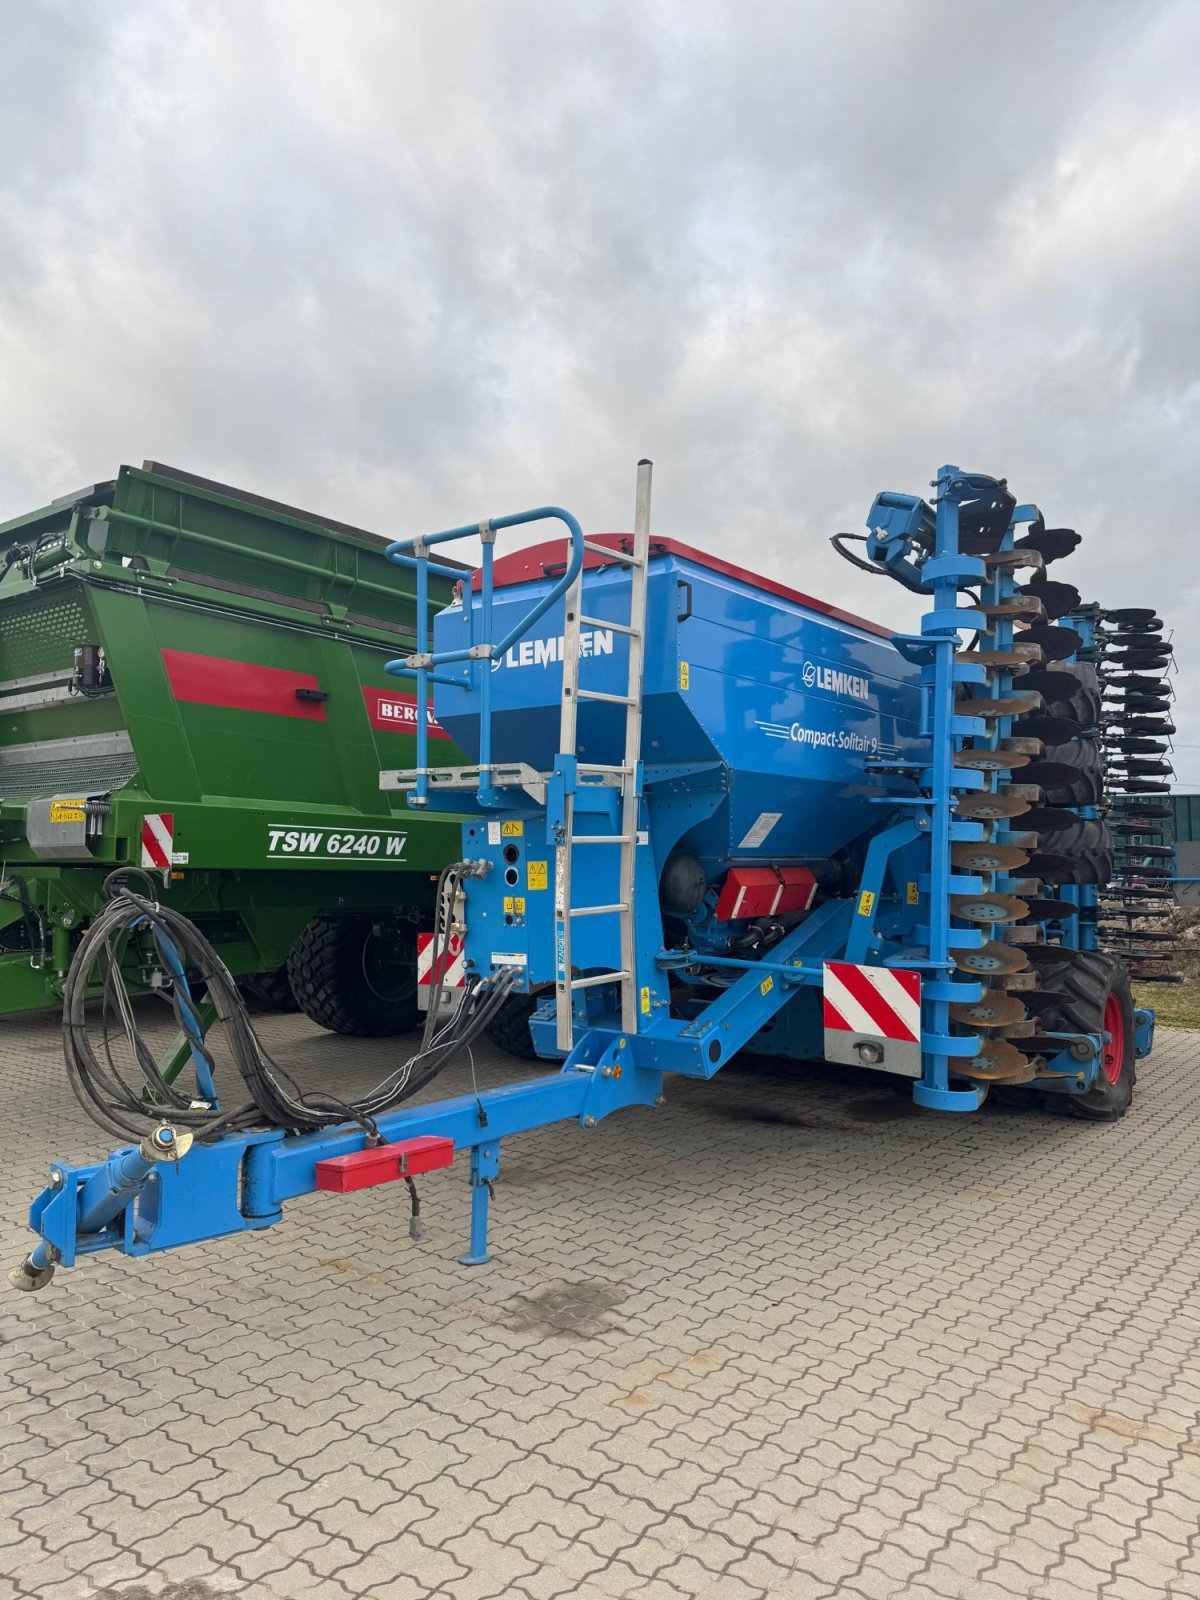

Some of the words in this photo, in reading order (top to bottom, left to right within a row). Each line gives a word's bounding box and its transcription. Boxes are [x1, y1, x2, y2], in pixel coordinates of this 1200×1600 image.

[816, 665, 869, 700] LEMKEN
[790, 722, 870, 753] Compact-Solitair
[871, 737, 878, 754] 9
[268, 830, 324, 853] TSW
[326, 833, 381, 855] 6240
[385, 836, 407, 856] W
